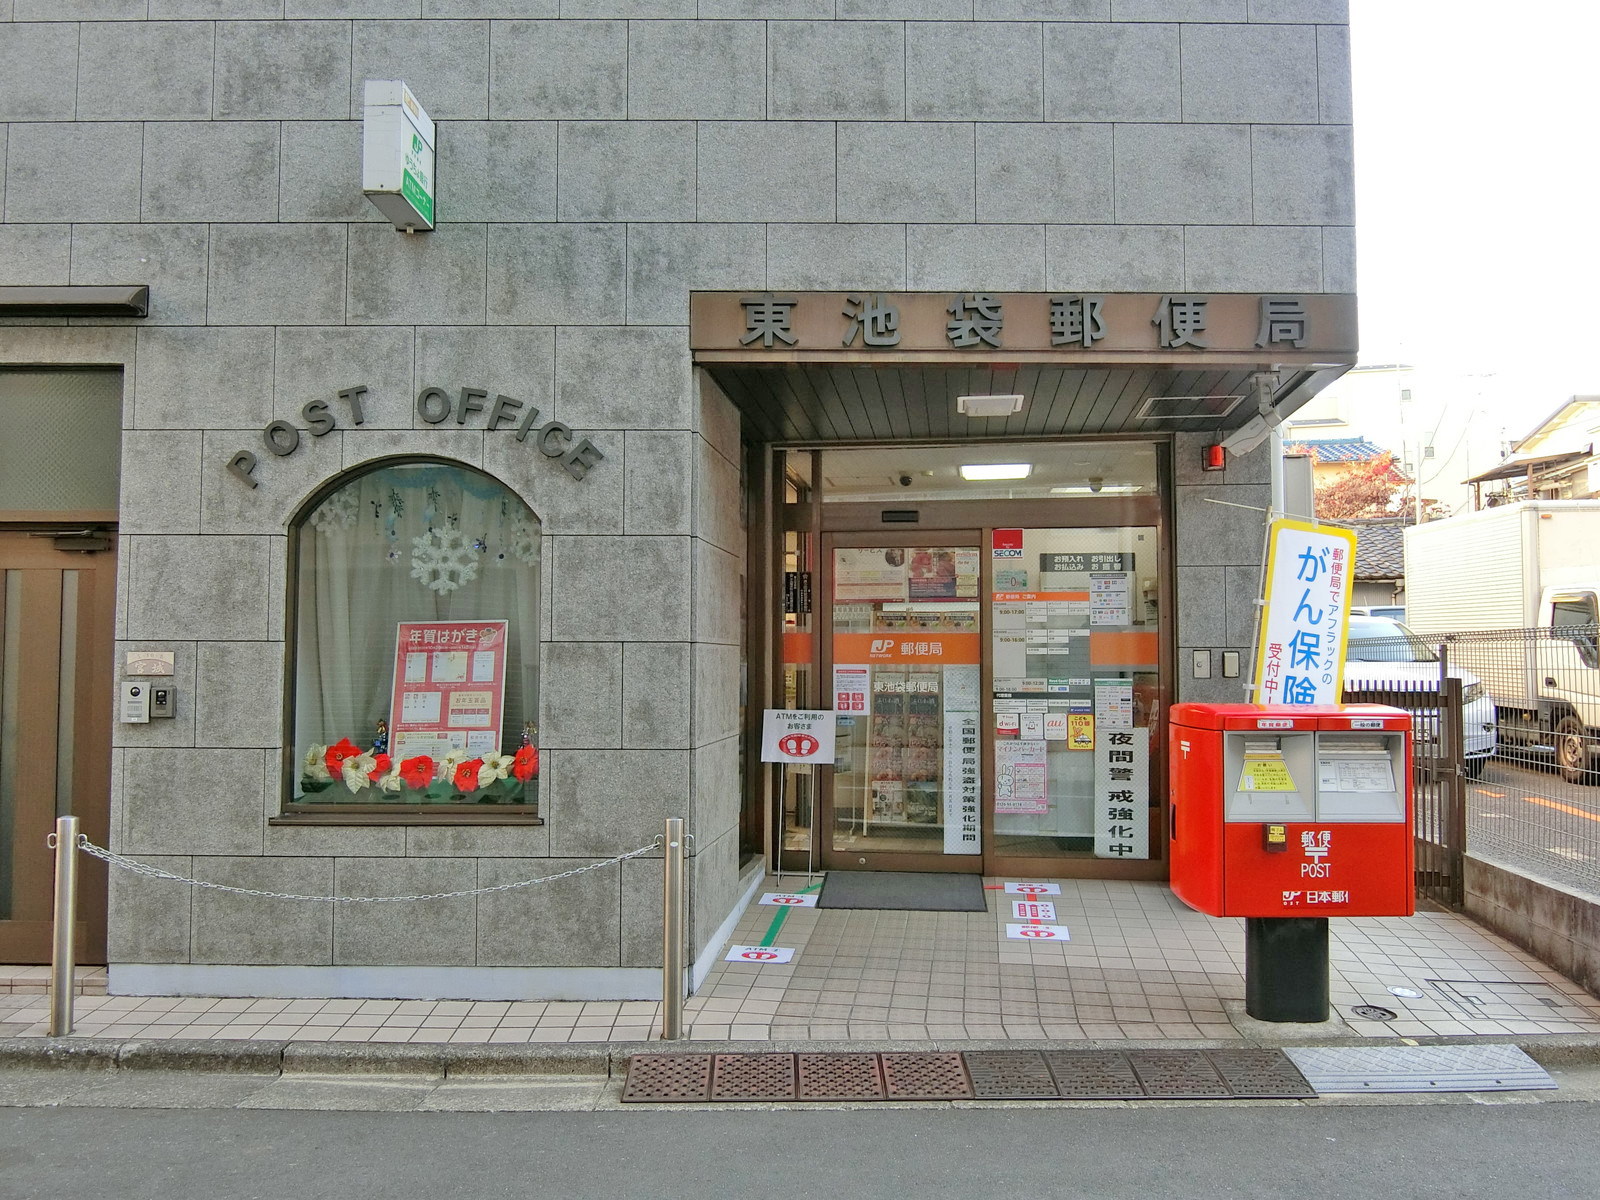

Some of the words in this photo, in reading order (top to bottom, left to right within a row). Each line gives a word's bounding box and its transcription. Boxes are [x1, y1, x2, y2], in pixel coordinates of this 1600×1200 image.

[404, 151, 429, 190] ゆうちょ銀行
[404, 173, 431, 208] ATMコーナー
[739, 293, 1312, 349] 東池袋郵便局
[225, 384, 369, 490] POST
[416, 386, 605, 481] OFFICE
[994, 549, 1022, 557] SECOM
[1053, 555, 1084, 563] お預入れ
[1091, 555, 1121, 563] お引出し
[1054, 563, 1084, 571] お払込み
[1321, 547, 1345, 685] 郵便局でアフラックの
[1282, 546, 1331, 704] がん保険
[409, 628, 478, 644] 年賀はがき
[900, 642, 943, 656] 郵便局
[873, 681, 939, 693] 東池袋郵便局
[775, 712, 825, 721] ATMをご利用の
[1047, 720, 1065, 728] au
[787, 722, 813, 731] お客さま
[961, 718, 977, 842] 全国郵便局強盗対策強化期間
[1107, 732, 1135, 857] 夜間警戒強化中
[1300, 830, 1332, 848] 郵便
[1300, 863, 1332, 878] POST
